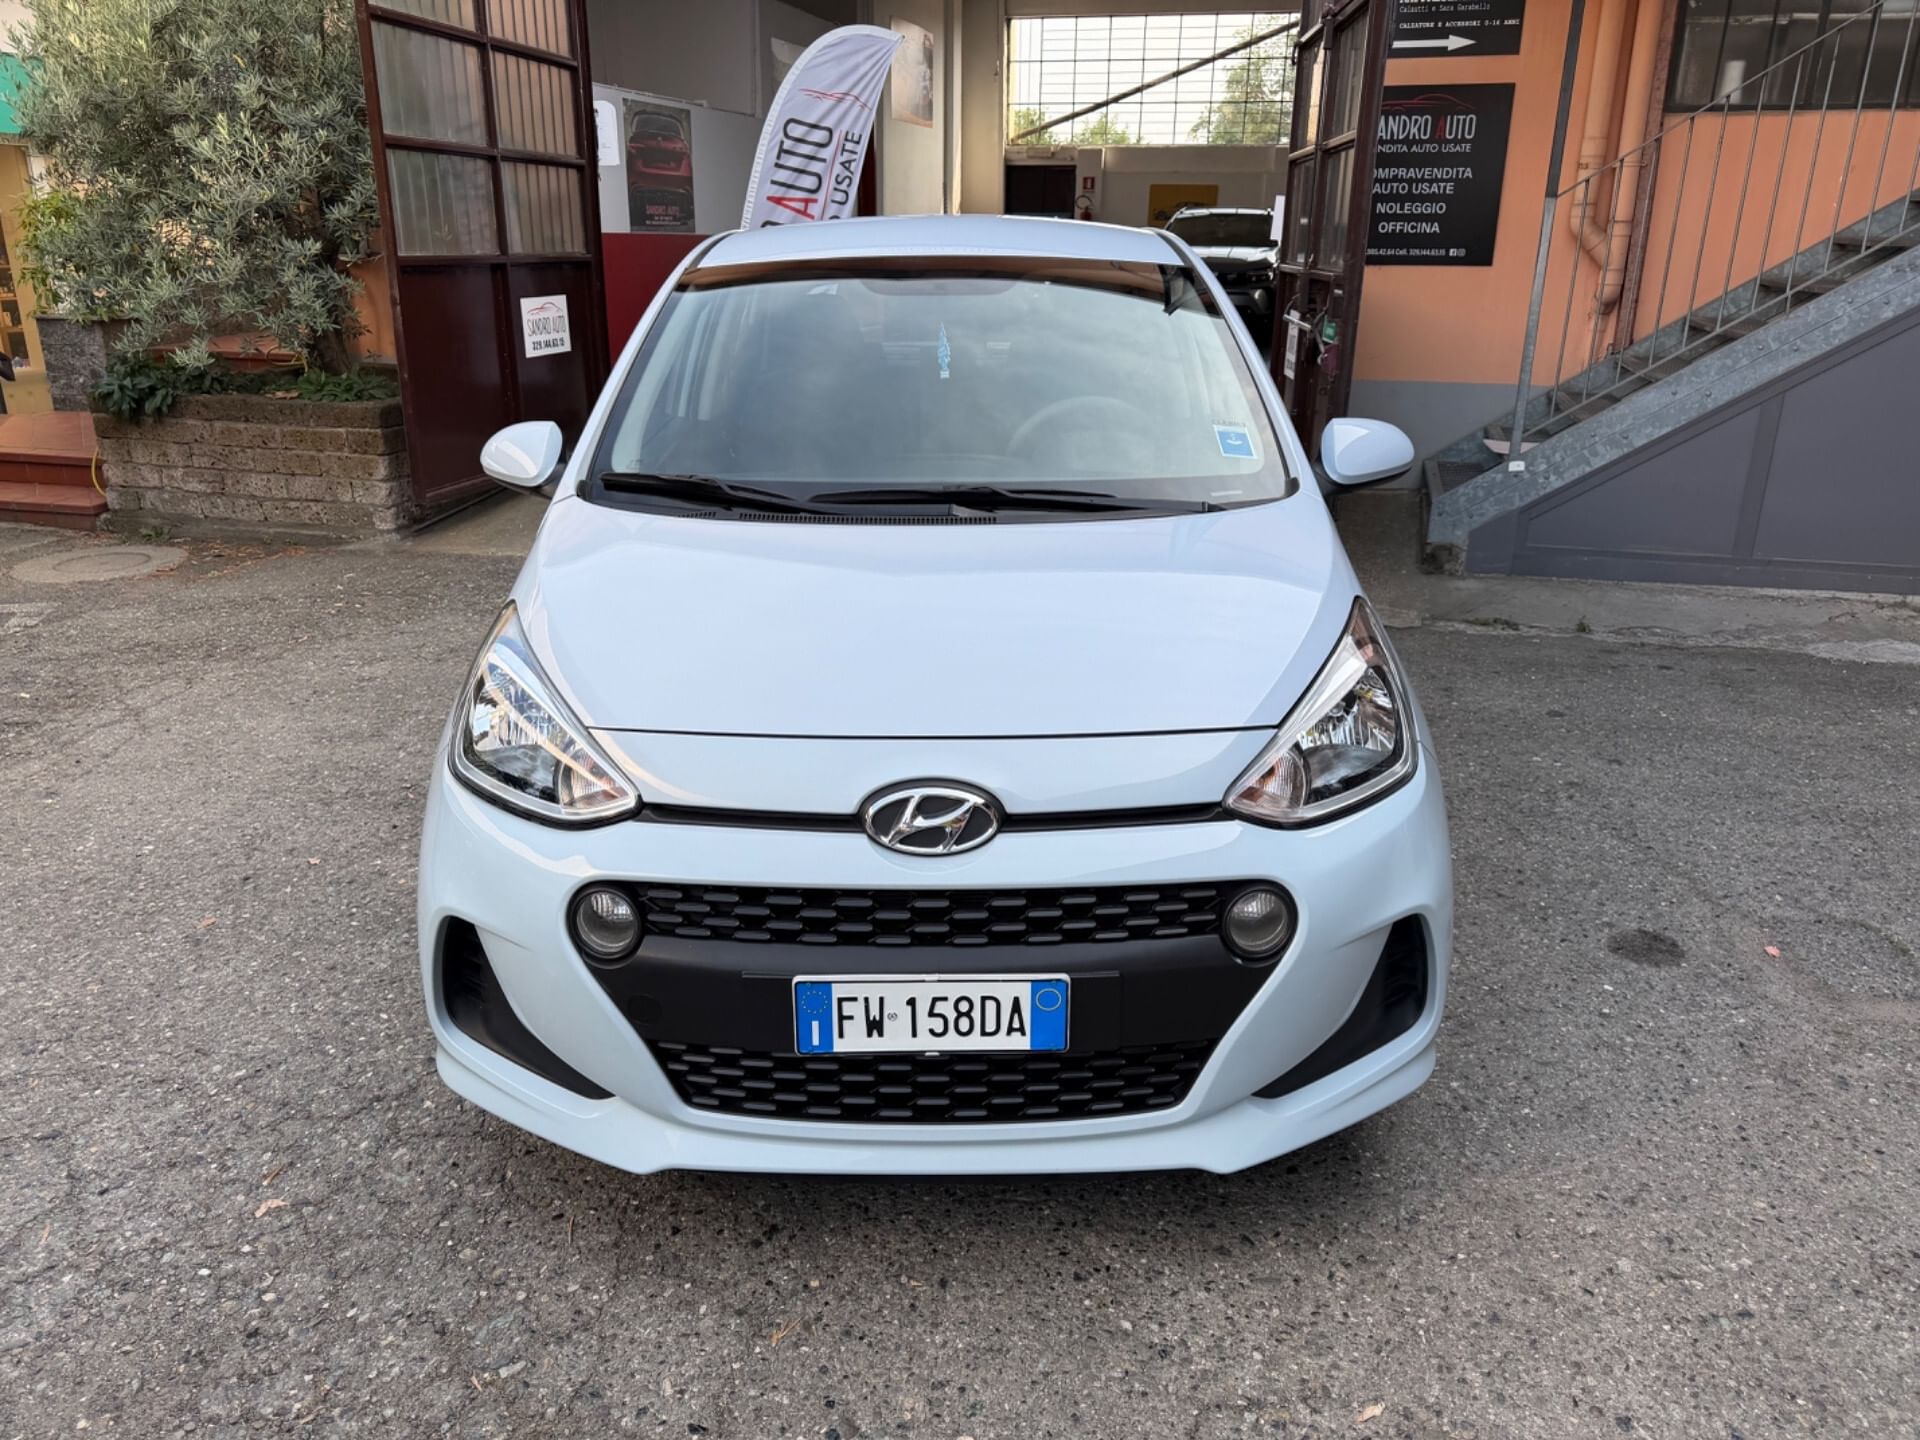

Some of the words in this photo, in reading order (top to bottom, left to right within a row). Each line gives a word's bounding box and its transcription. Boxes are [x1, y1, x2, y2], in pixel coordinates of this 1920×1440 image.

[1377, 114, 1432, 140] ANDRO
[1435, 114, 1477, 140] AUTO
[1377, 144, 1409, 153] NDITA
[1410, 144, 1439, 153] AUTO
[1442, 143, 1472, 153] USATE
[766, 117, 834, 220] AUTO
[830, 130, 863, 206] USATE
[1373, 167, 1473, 179] MPRAVENDITA
[1372, 182, 1408, 194] AUTO
[1412, 182, 1455, 194] USATE
[1376, 202, 1447, 214] NOLEGGIO
[1378, 221, 1441, 234] OFFICINA
[836, 996, 885, 1039] FW
[905, 995, 1027, 1039] 158DA
